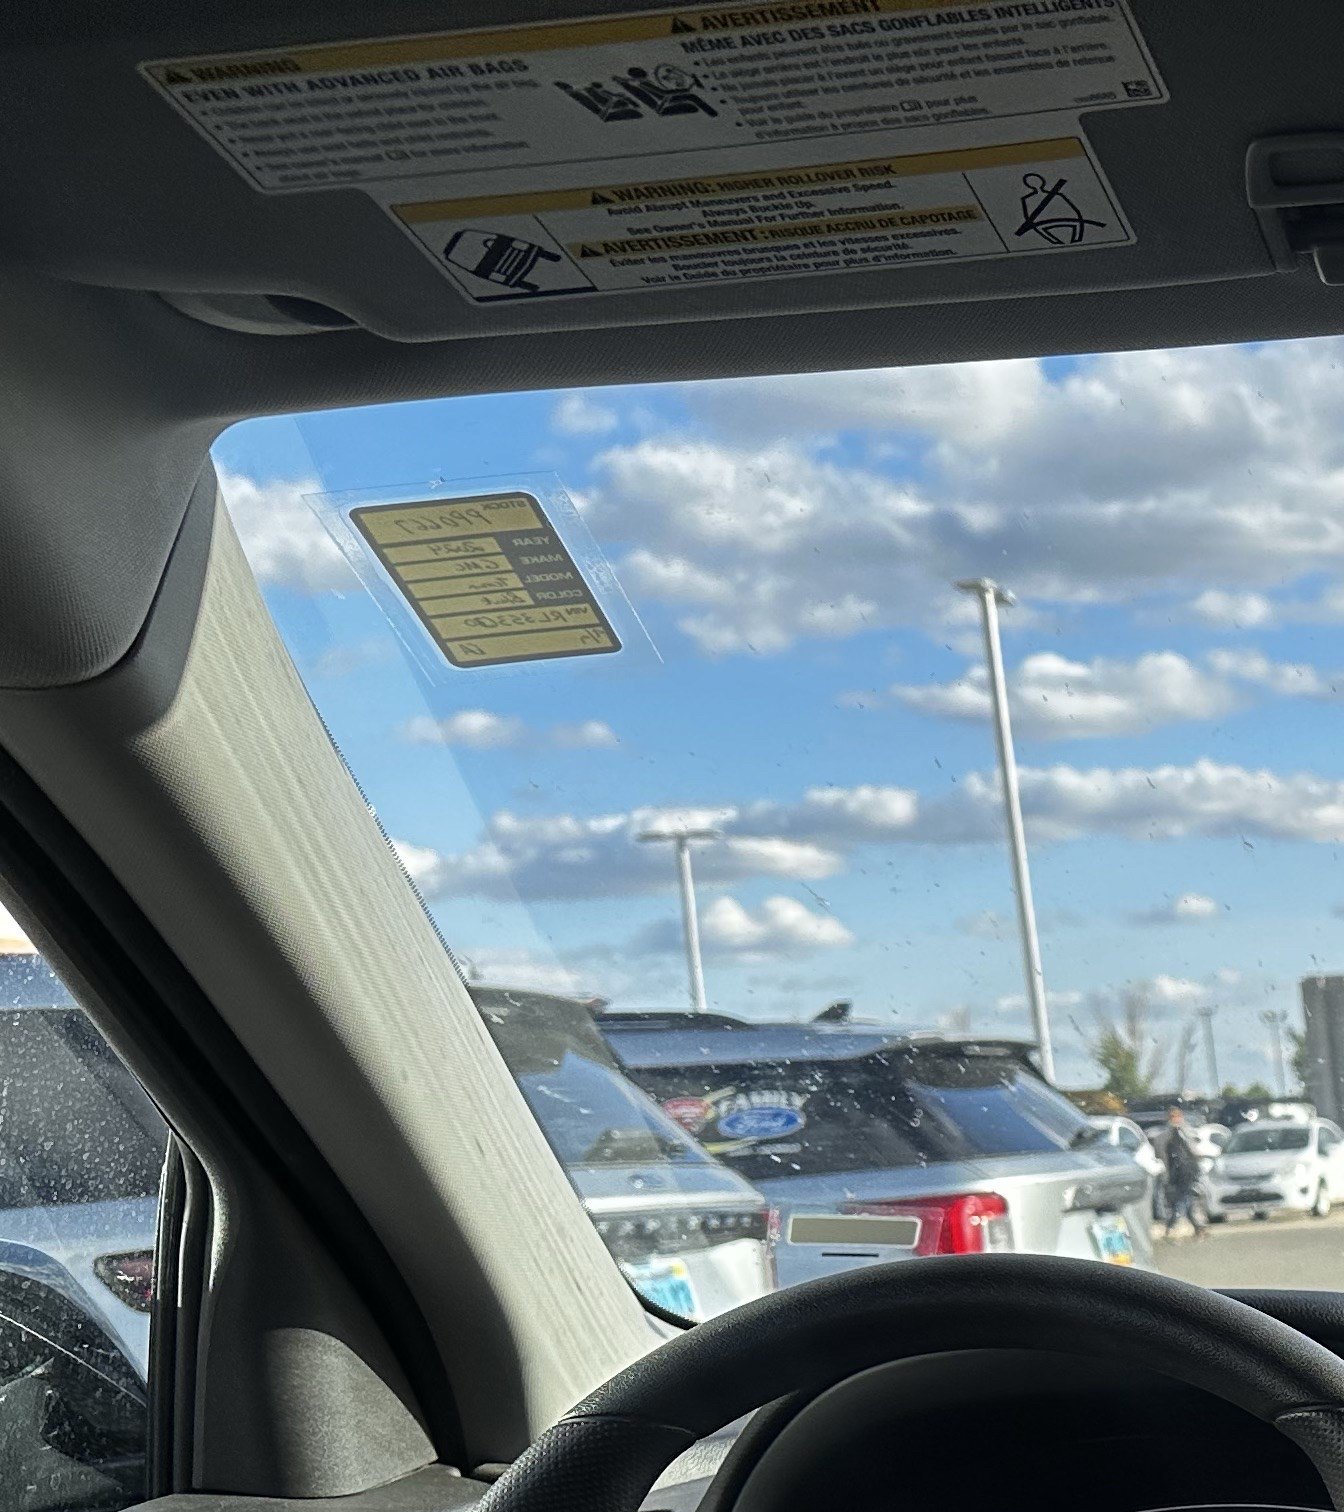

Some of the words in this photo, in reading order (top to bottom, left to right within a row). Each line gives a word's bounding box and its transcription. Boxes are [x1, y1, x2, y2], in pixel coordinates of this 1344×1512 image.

[740, 30, 783, 48] AVEC
[787, 25, 825, 43] DES
[827, 20, 875, 39] SACS
[879, 8, 990, 31] GONFLABLES
[182, 84, 240, 102] EVEN
[244, 79, 300, 97] WITH
[306, 68, 419, 91] ADVANCED
[427, 64, 463, 79] AIR
[467, 57, 528, 76] BAGS
[191, 58, 300, 82] WARNING
[611, 180, 711, 203] WARNING:
[719, 175, 773, 192] HIGHER
[776, 168, 856, 187] ROLLOVER
[860, 164, 896, 177] RISK
[602, 228, 757, 255] AVERTISSEMENT
[825, 219, 875, 233] ACCRU
[878, 217, 898, 228] DE
[899, 209, 976, 226] CAPOTAGE
